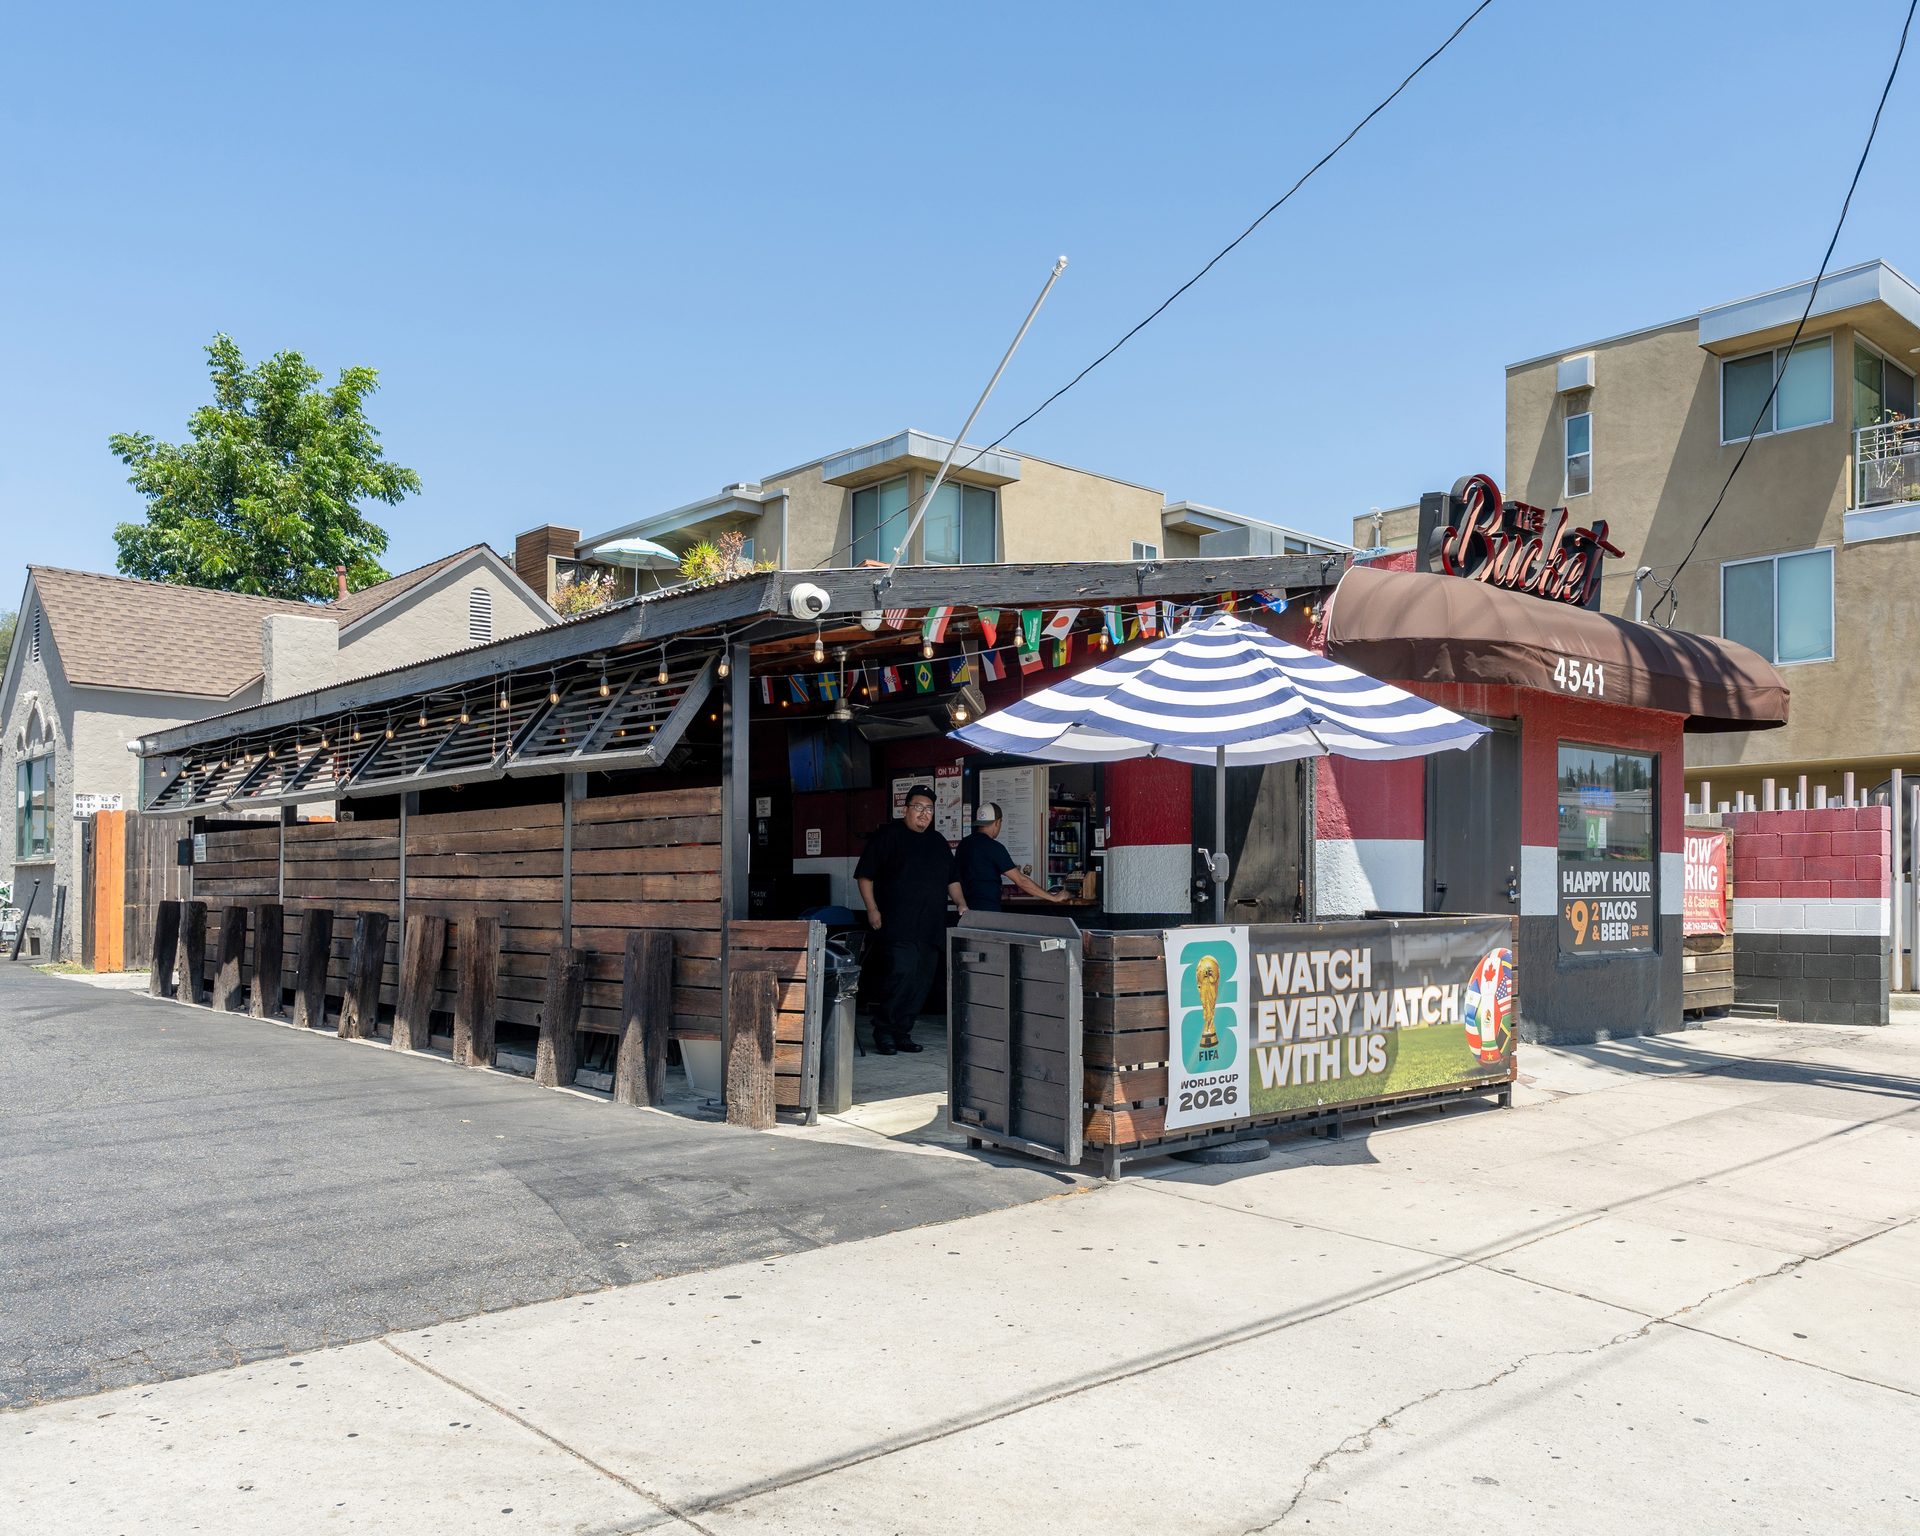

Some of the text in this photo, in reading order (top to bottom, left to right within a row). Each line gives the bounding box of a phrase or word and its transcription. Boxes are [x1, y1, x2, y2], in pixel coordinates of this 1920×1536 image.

[1514, 501, 1546, 534] THE
[1429, 474, 1625, 606] Bucket
[1554, 657, 1604, 696] 4541
[948, 767, 959, 775] TAP
[1588, 823, 1596, 841] A
[1563, 871, 1650, 892] HAPPY HOUR
[1684, 864, 1718, 890] RING
[1592, 901, 1637, 921] 2 TACOS
[1592, 922, 1629, 941] & BEER
[1256, 948, 1371, 996] WATCH
[1257, 984, 1460, 1043] EVERY MATCH
[1199, 1050, 1219, 1061] FIFA
[1256, 1034, 1388, 1090] WITH US
[1180, 1074, 1239, 1089] WORLD CUP
[1179, 1086, 1237, 1112] 2026
